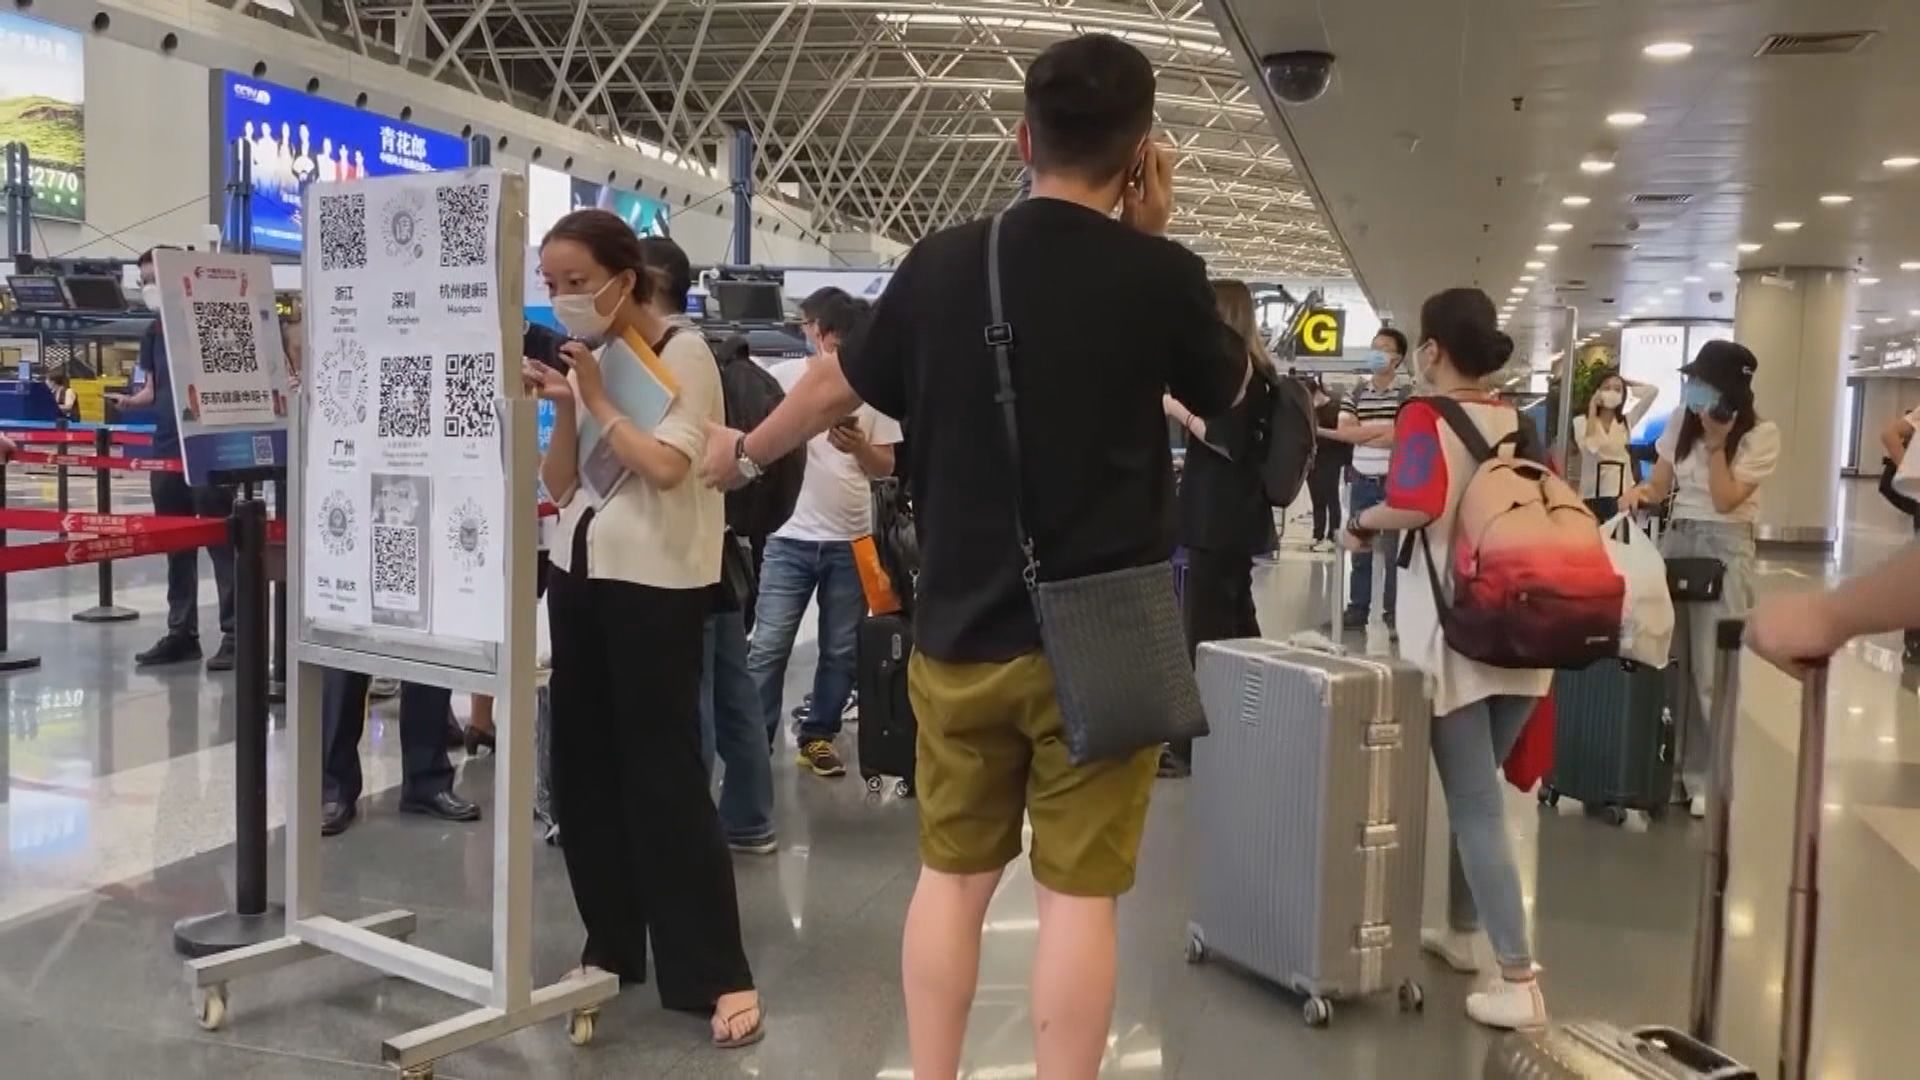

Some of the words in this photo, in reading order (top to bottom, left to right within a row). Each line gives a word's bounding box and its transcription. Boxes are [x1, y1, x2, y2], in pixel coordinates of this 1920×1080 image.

[379, 126, 428, 161] 青花郎
[391, 291, 416, 309] 深圳
[1303, 314, 1337, 352] G
[333, 438, 355, 456] 广州
[1401, 433, 1437, 487] 8
